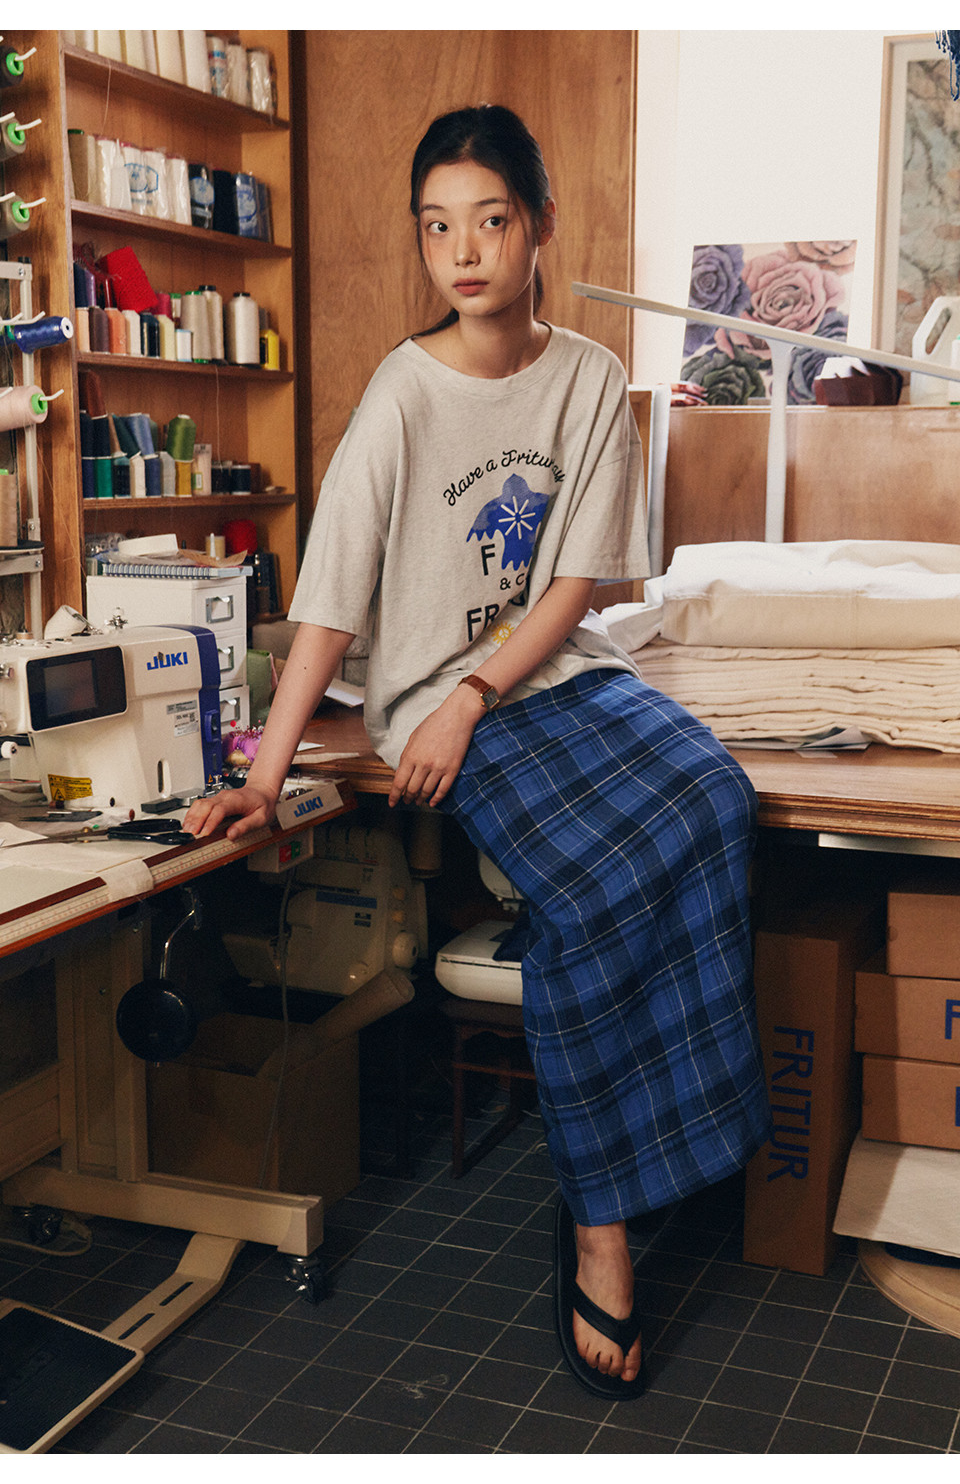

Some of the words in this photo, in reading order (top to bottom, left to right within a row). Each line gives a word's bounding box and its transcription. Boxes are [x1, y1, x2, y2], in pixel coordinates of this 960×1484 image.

[443, 466, 484, 506] Have
[486, 459, 498, 473] a
[480, 543, 496, 576] F
[499, 577, 511, 590] &
[146, 651, 189, 671] JUKI
[293, 795, 324, 818] JUKI
[766, 1025, 815, 1183] FRITUR
